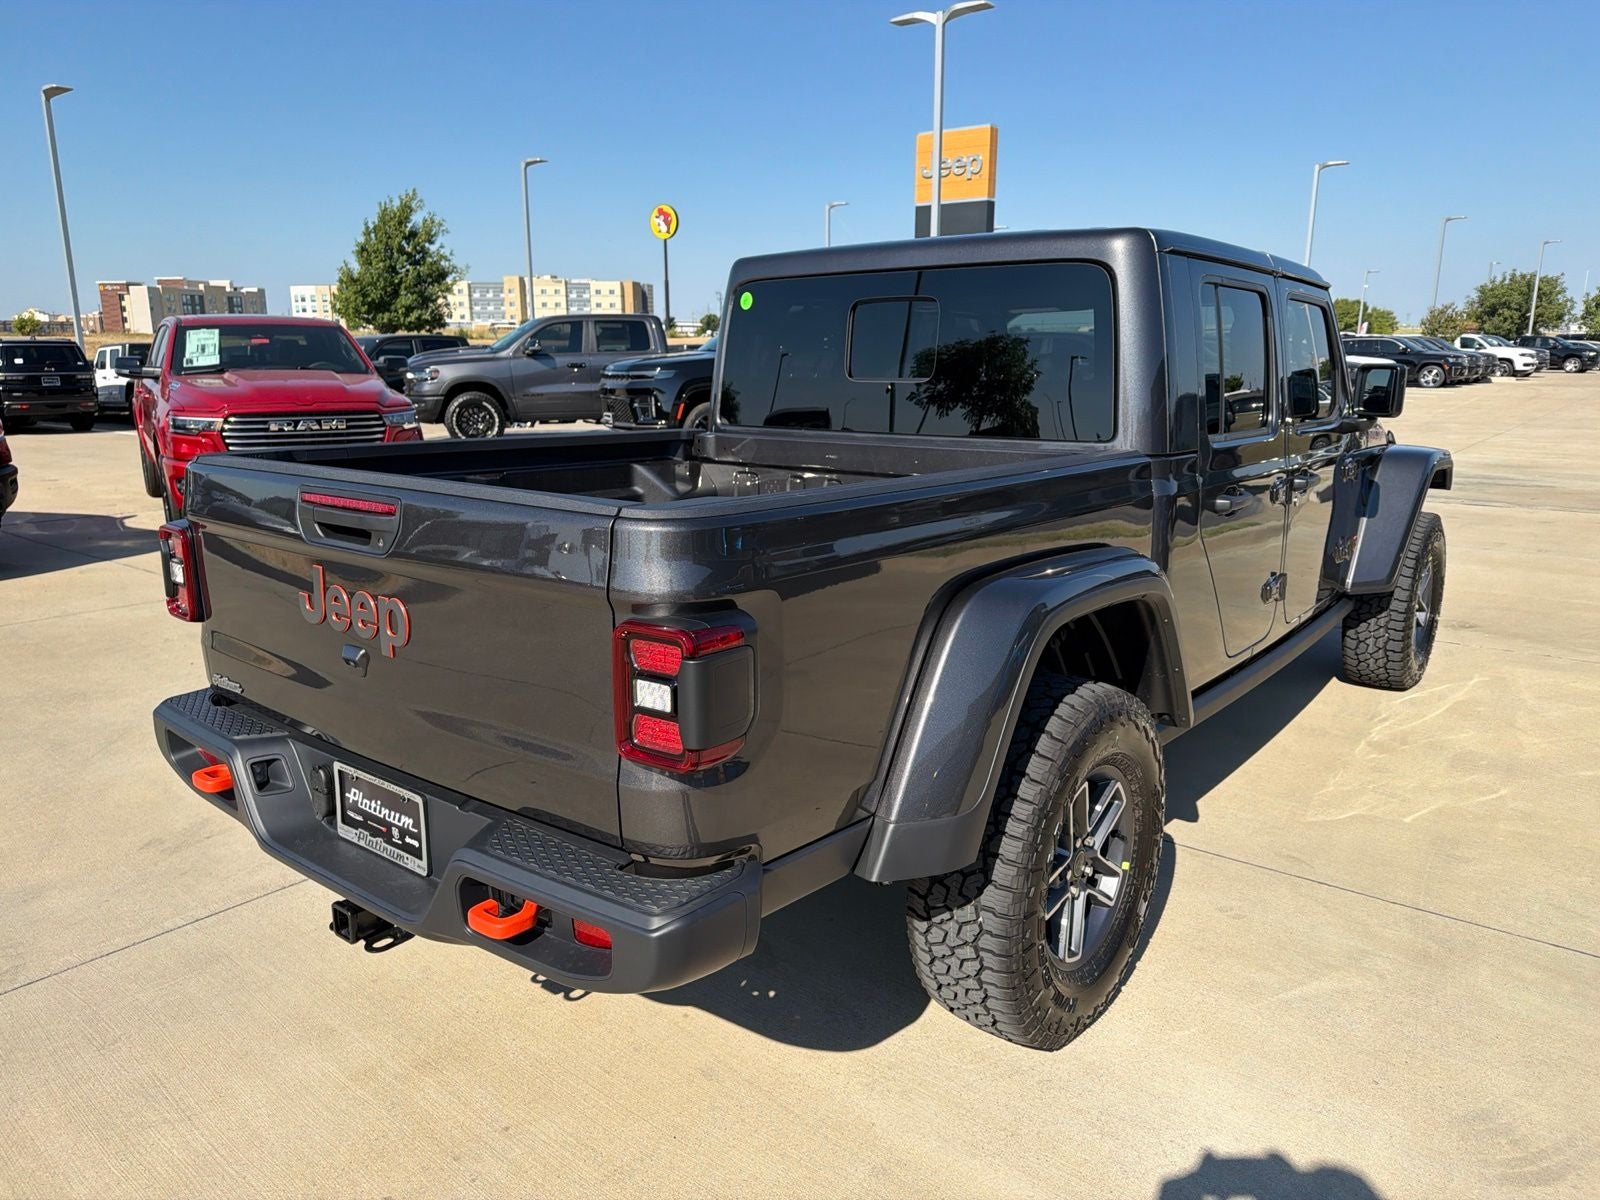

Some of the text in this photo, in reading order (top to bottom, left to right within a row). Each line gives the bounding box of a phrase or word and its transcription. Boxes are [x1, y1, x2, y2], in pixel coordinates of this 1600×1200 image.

[268, 419, 347, 432] RAM
[298, 563, 410, 659] Jeep
[345, 787, 418, 833] Platinum
[358, 829, 410, 867] Platinum
